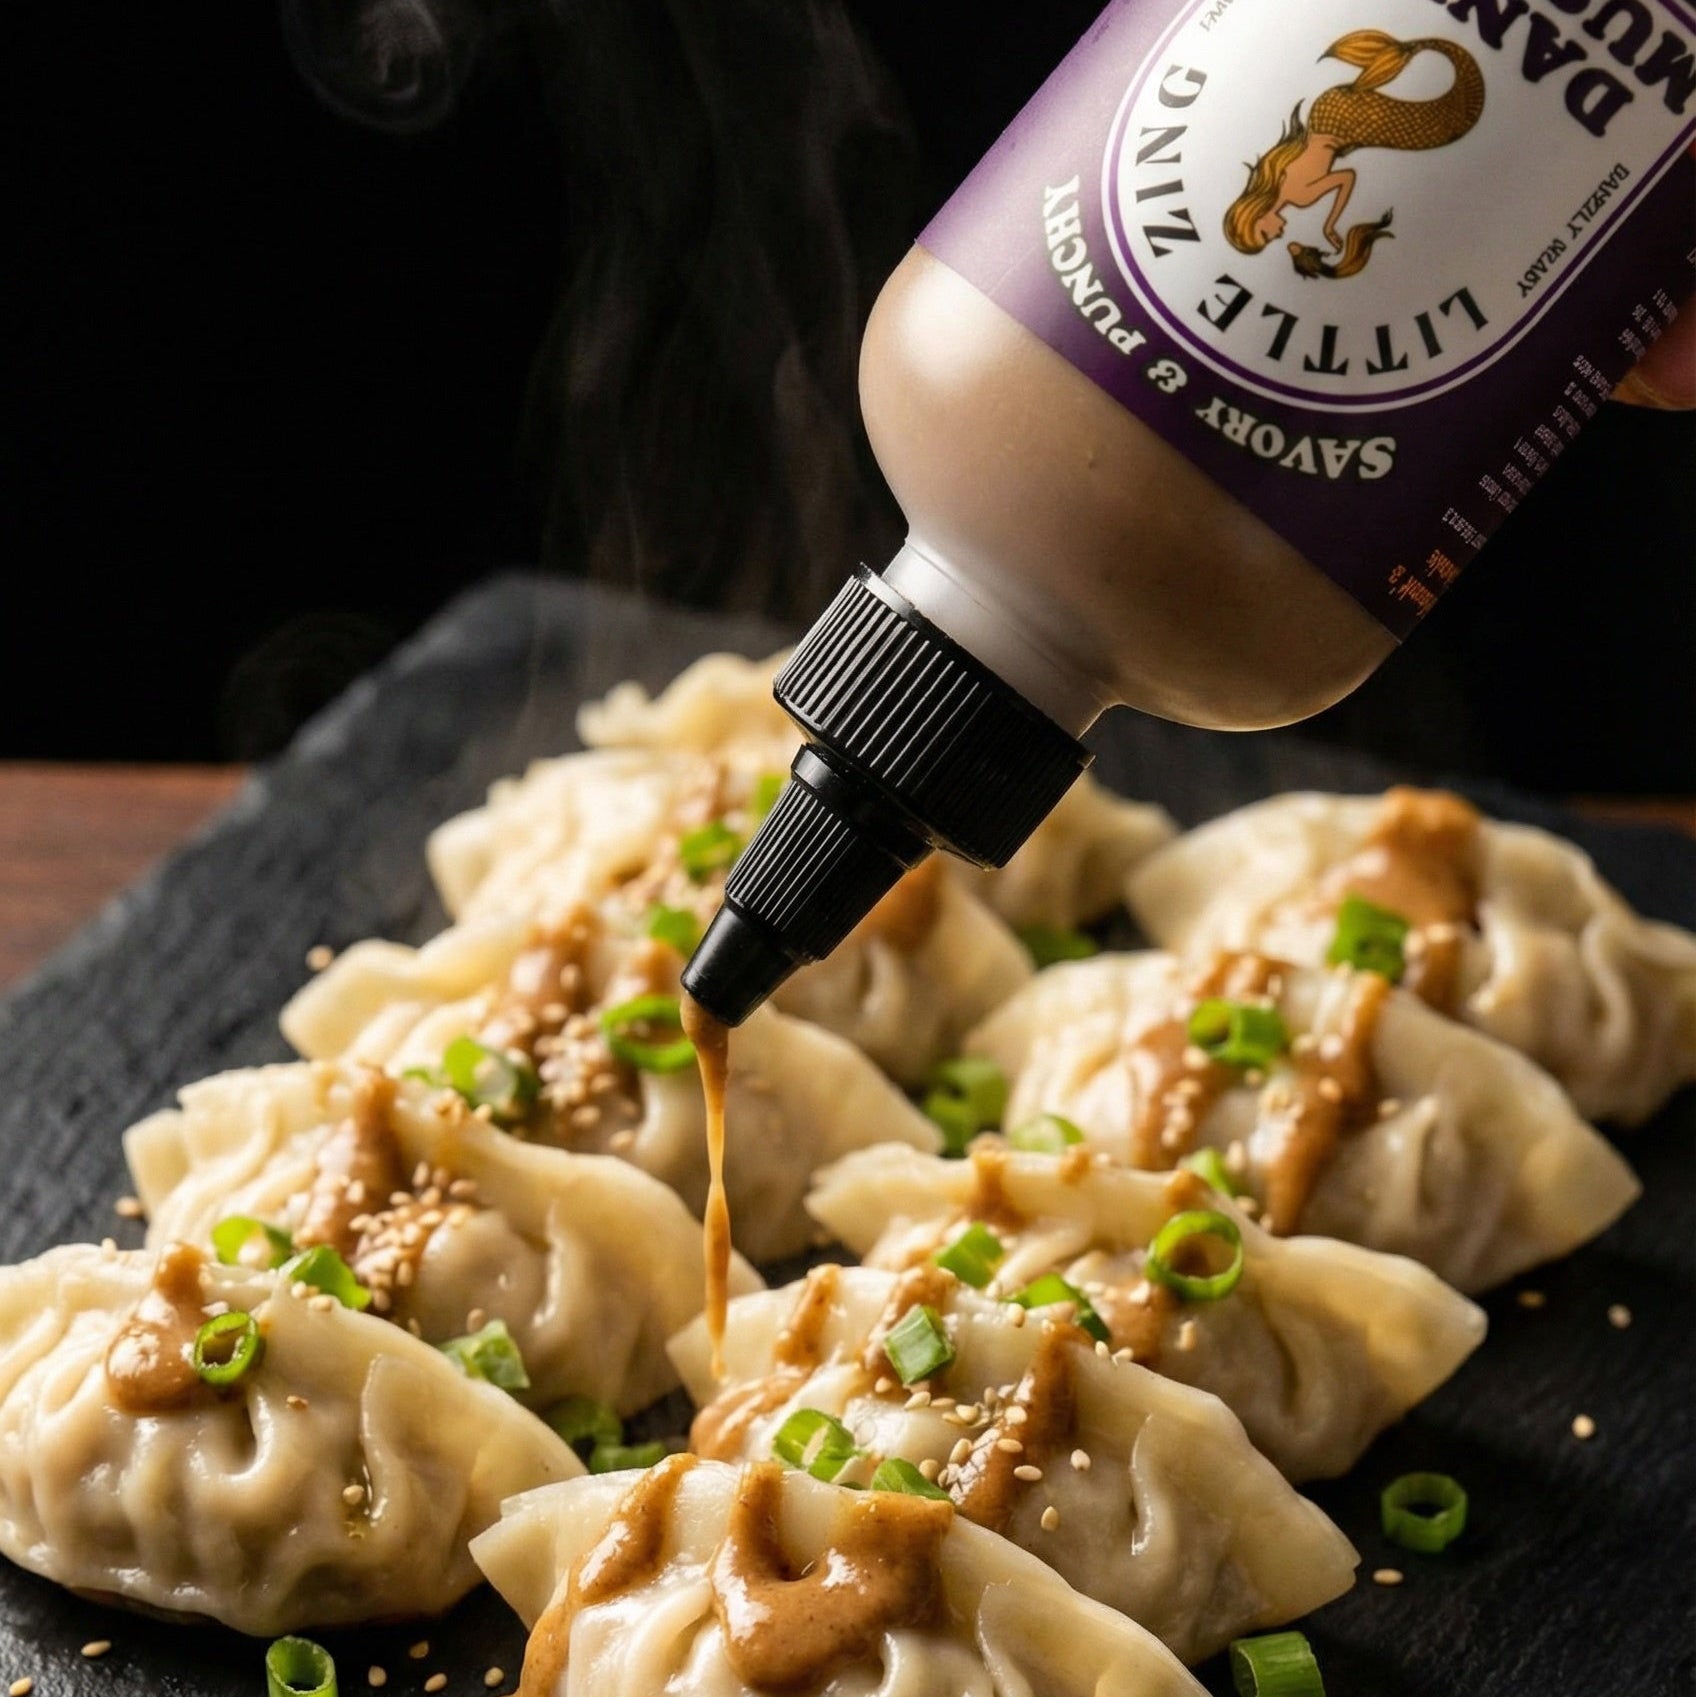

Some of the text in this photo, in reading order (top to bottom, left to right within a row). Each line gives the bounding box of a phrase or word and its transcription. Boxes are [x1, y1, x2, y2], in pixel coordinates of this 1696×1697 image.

[1135, 64, 1489, 376] LITTLE ZING
[1437, 0, 1634, 138] DAN
[1042, 174, 1397, 479] SAVORY & PUNCHY
